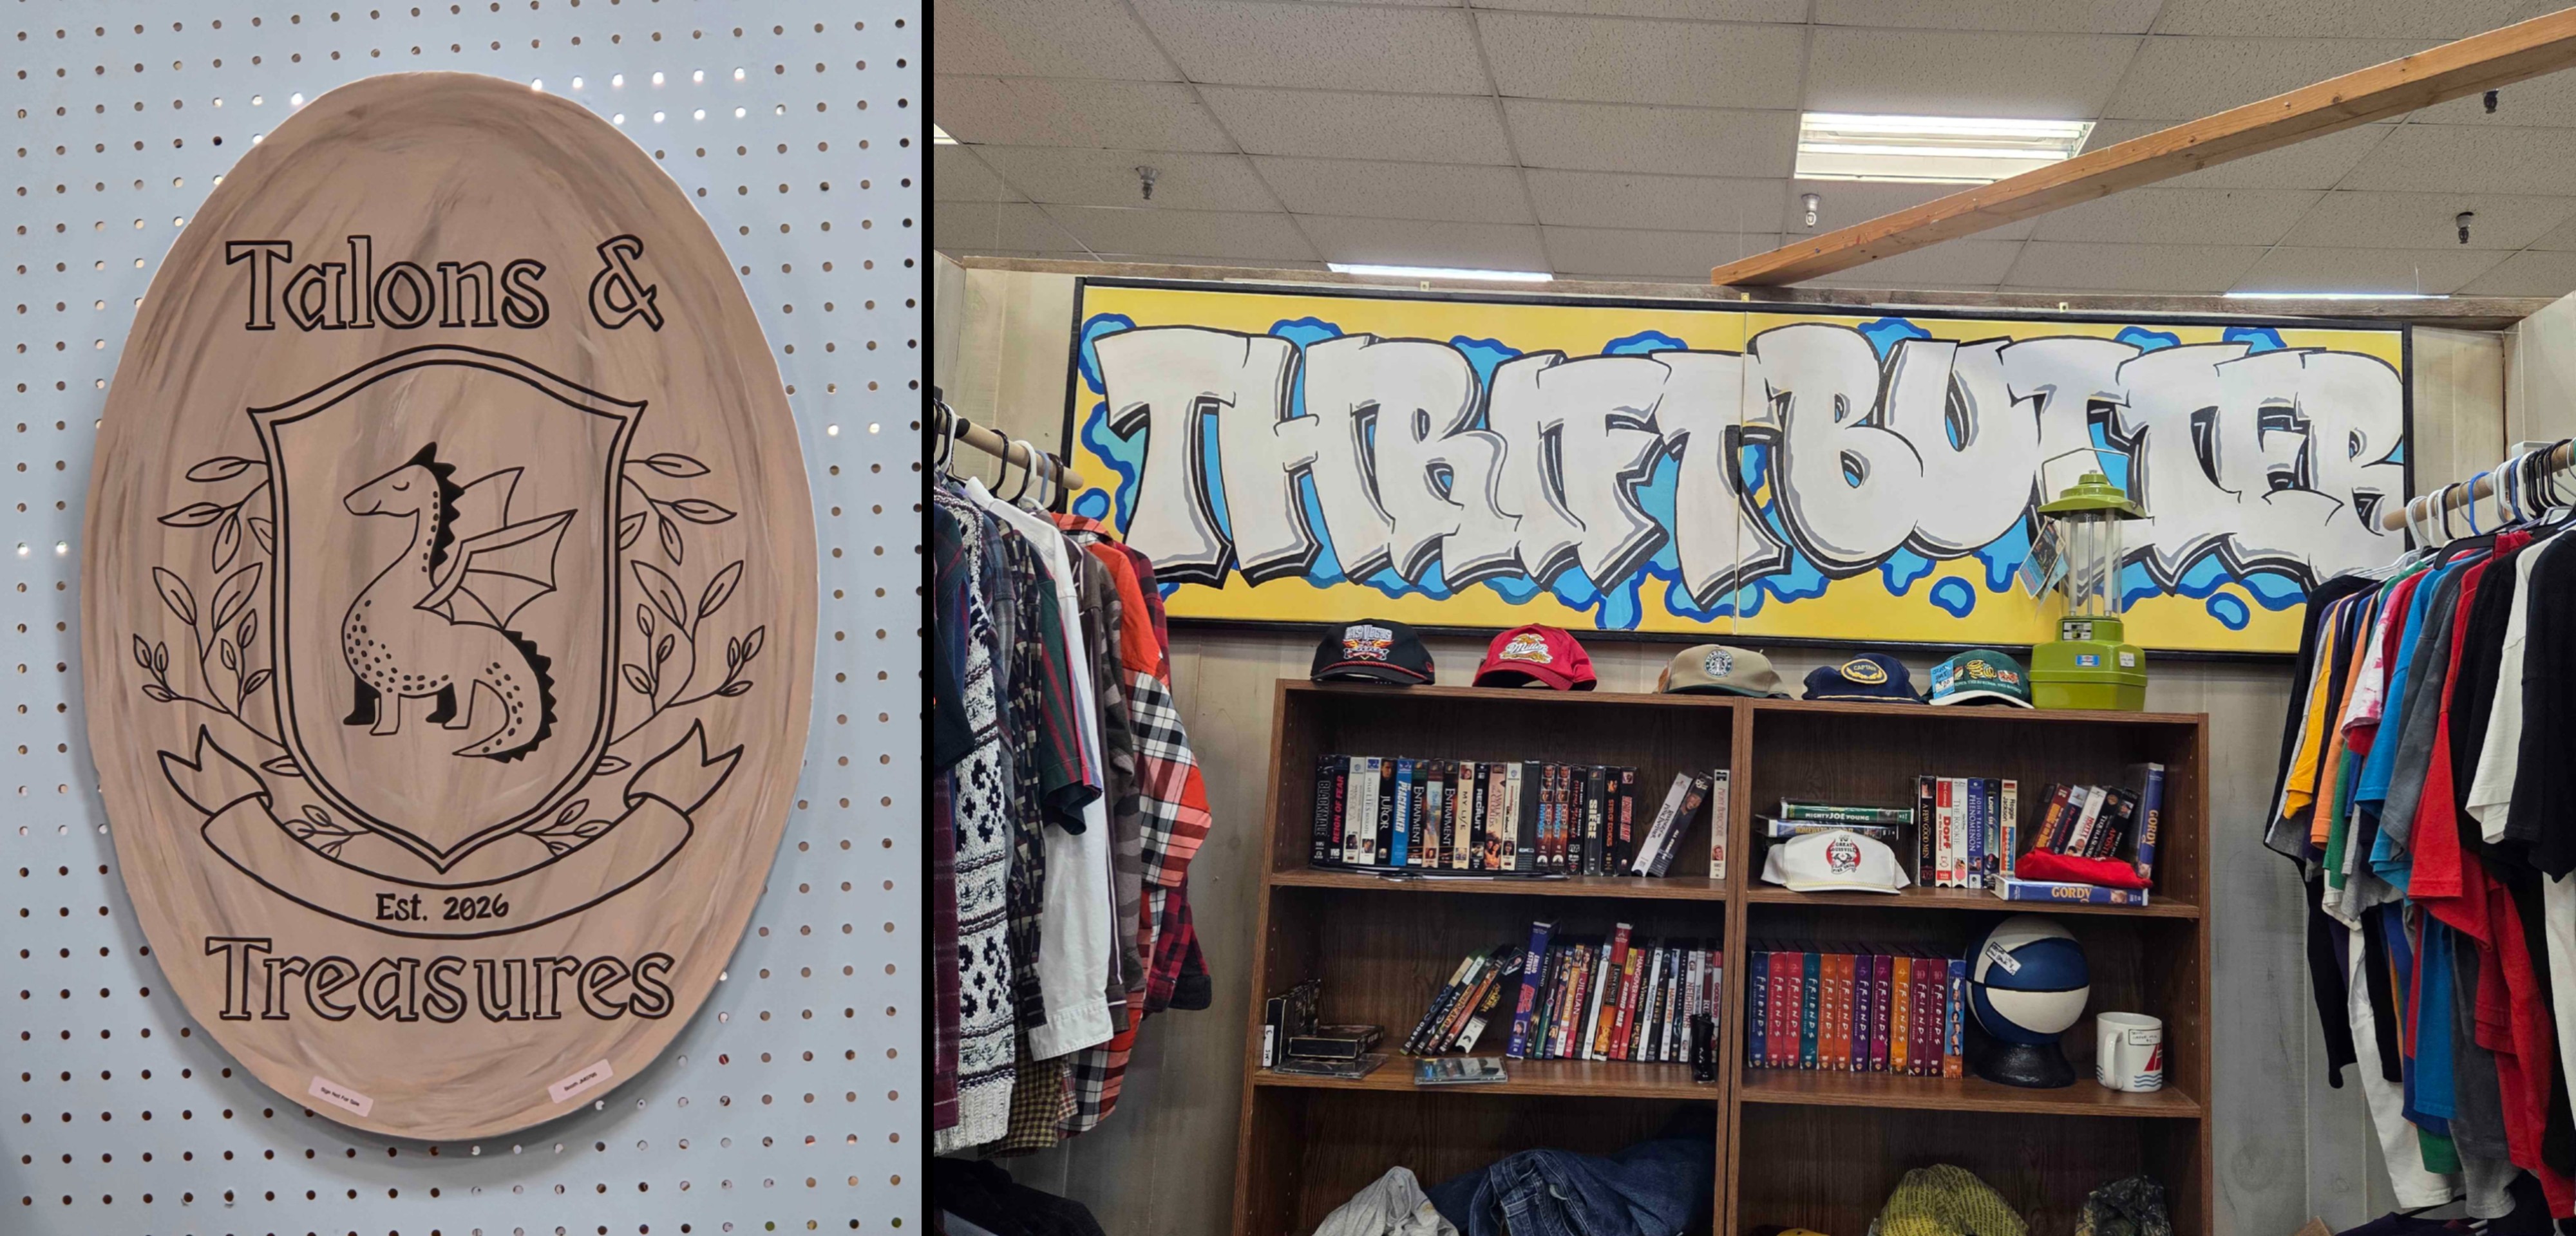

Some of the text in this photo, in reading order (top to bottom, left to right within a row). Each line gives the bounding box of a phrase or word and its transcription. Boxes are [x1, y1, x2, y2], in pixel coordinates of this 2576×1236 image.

[226, 234, 665, 332] Talons &
[1092, 323, 2404, 612] THRIFT BUTTER
[1345, 624, 1392, 640] LAS VEGAS
[1506, 642, 1548, 655] Miller
[1314, 780, 1331, 836] BLACKMALE
[1332, 775, 1344, 843] REIGN OF FEAR
[1380, 796, 1391, 830] JUROR
[1396, 781, 1408, 833] PEACEMAKER
[1412, 787, 1425, 843] ENTRAPMENT
[1462, 791, 1468, 805] MY
[1474, 789, 1483, 830] RECRUIT
[1443, 789, 1455, 845] ENTRAPMENT
[1537, 803, 1546, 839] IMPACT
[1553, 803, 1562, 839] IMPACT
[1588, 799, 1598, 839] SIEGE
[1829, 812, 1846, 820] JOE
[2142, 809, 2159, 847] GORDY
[375, 893, 509, 921] Est. 2026
[2051, 886, 2092, 903] GORDY
[1524, 951, 1535, 975] ESTEVEZ
[1531, 951, 1540, 973] EMILIO
[1544, 956, 1549, 964] AM
[1631, 956, 1643, 993] HANGOVER
[205, 937, 675, 1023] Treasures
[1573, 978, 1586, 1015] JILLIAN
[1620, 981, 1629, 1009] CARDIO
[1436, 991, 1461, 1024] HALO
[1562, 993, 1575, 1020] AUSTIN
[1638, 986, 1647, 1012] VIKINGS
[1683, 982, 1694, 1029] NEIGHBORS
[1616, 1009, 1624, 1027] MAX
[1665, 1009, 1674, 1024] FEET
[350, 1098, 360, 1107] Sale
